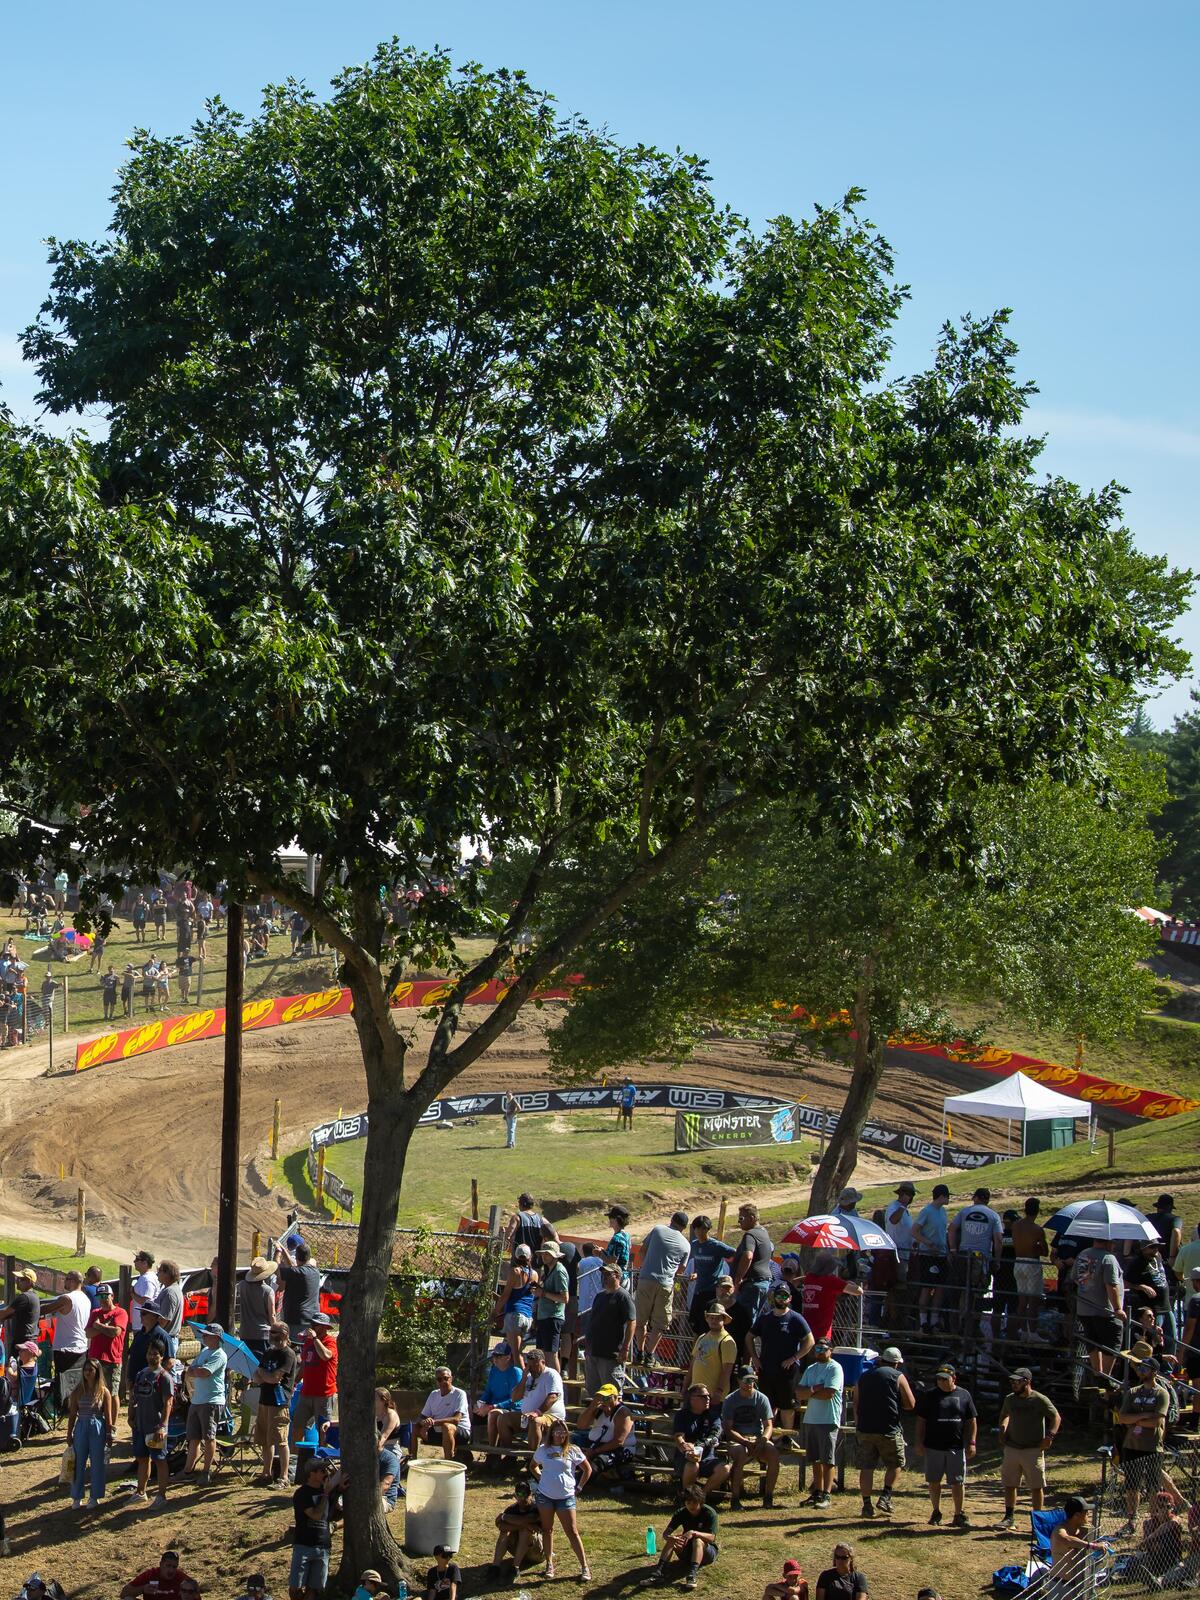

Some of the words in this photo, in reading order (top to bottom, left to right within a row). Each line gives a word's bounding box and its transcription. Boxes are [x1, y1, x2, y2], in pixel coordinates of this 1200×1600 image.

[669, 1089, 725, 1109] WPS
[703, 1115, 762, 1131] MONSTER
[711, 1132, 753, 1140] ENERGY
[904, 1135, 944, 1163] WPS
